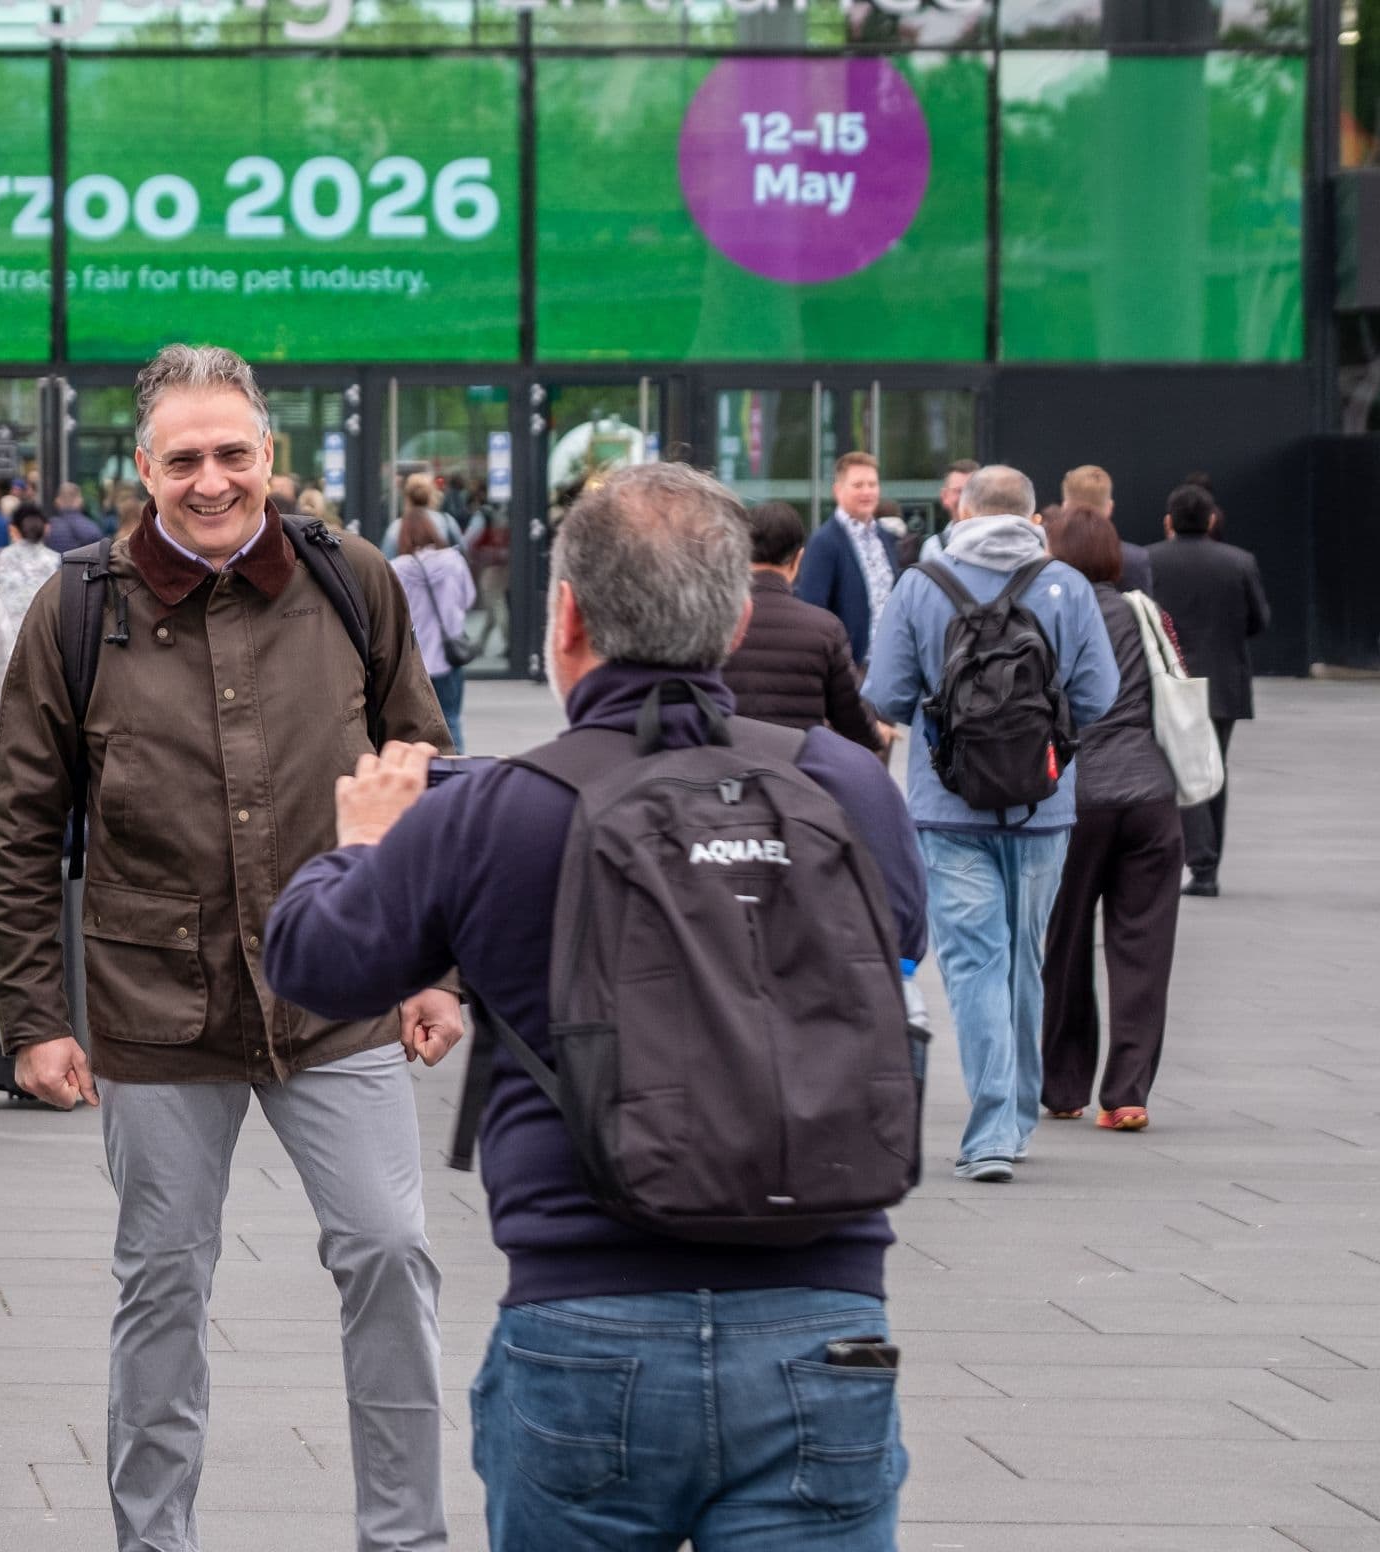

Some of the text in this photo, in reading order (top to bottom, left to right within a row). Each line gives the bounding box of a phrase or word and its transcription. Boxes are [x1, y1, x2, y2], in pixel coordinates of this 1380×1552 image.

[740, 111, 868, 154] 12–15
[224, 156, 500, 240] 2026
[753, 163, 856, 215] May
[81, 264, 133, 292] fair
[137, 264, 181, 291] for
[187, 264, 239, 292] the
[242, 265, 293, 295] pet
[299, 264, 431, 299] industry.
